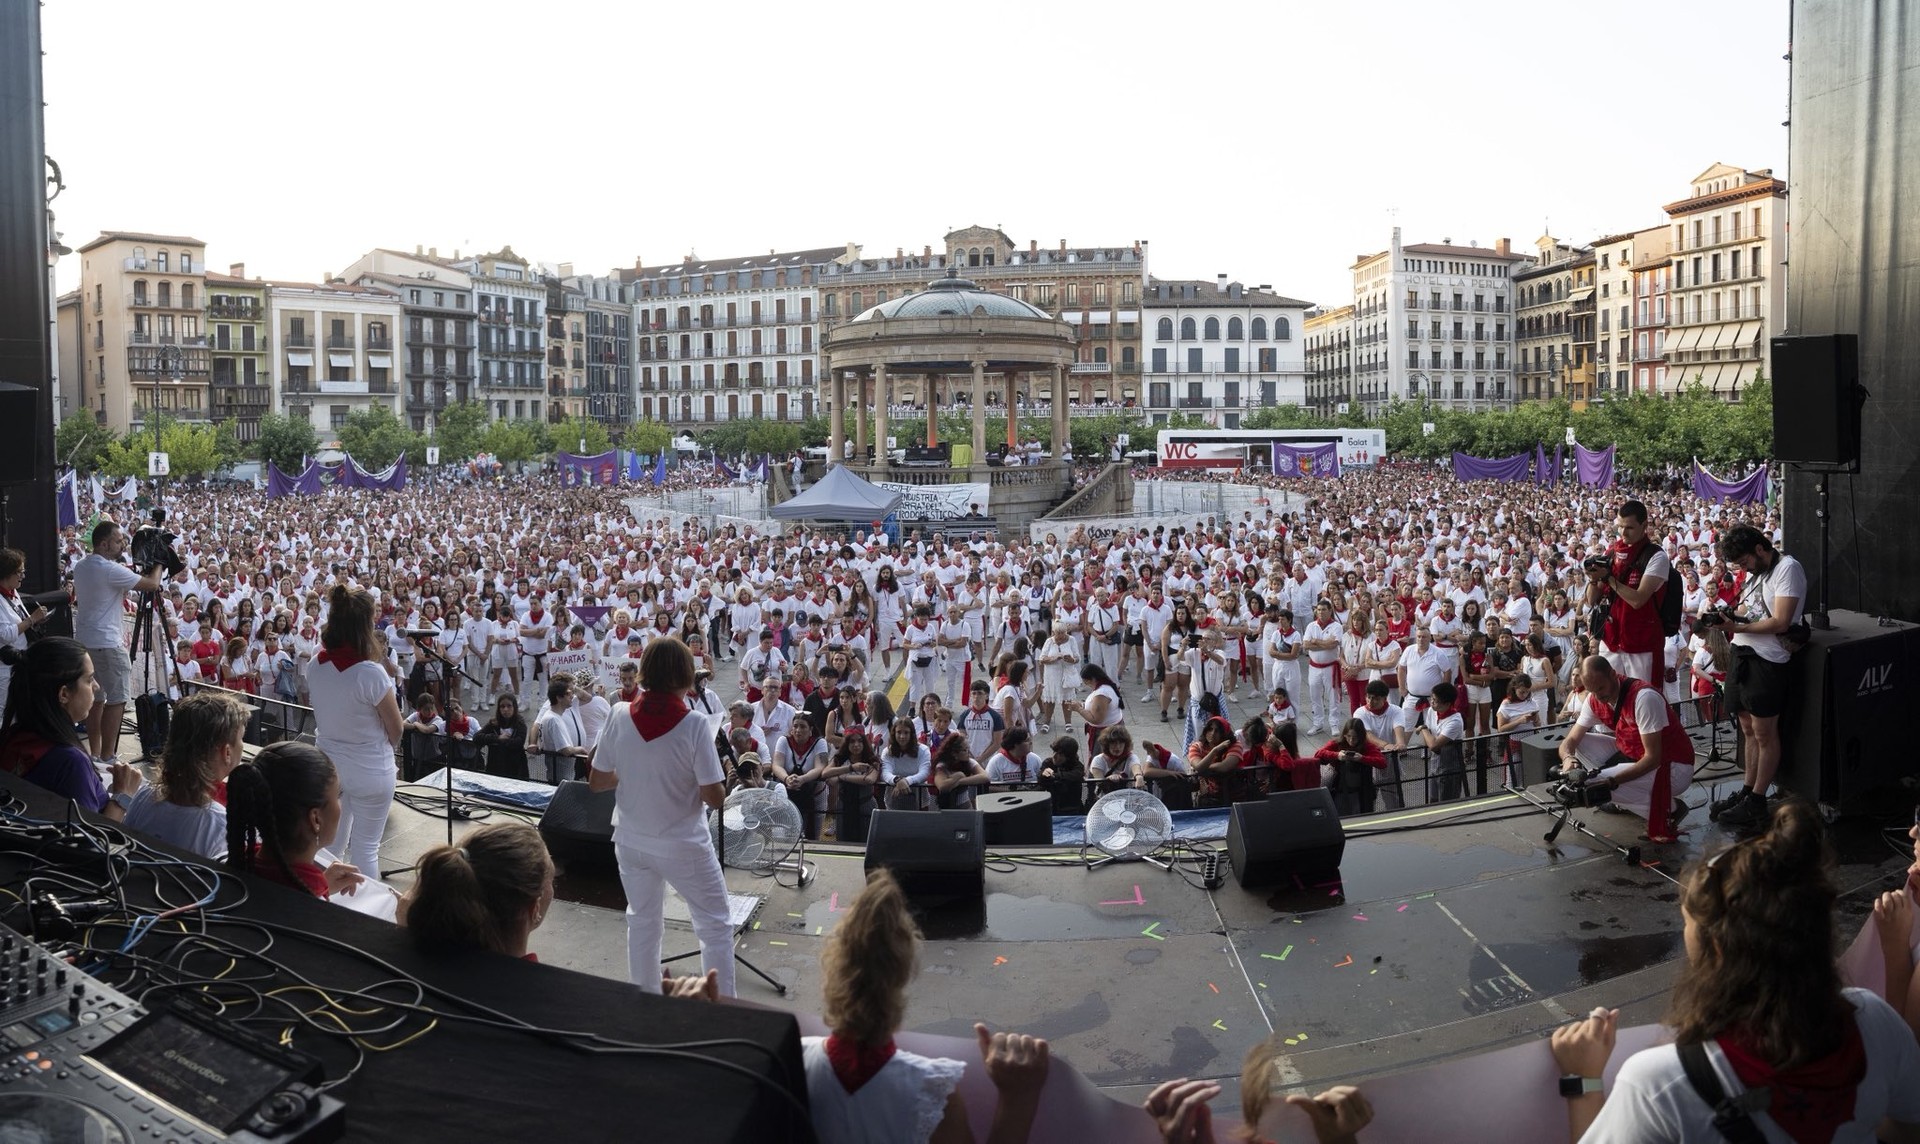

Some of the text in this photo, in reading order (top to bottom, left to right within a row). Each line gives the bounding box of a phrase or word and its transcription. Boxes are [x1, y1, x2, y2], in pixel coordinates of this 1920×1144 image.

[1405, 275, 1508, 290] HOTEL LA PERLA
[1165, 442, 1198, 459] WC
[1858, 663, 1892, 690] ALV
[967, 720, 990, 730] MARVEL
